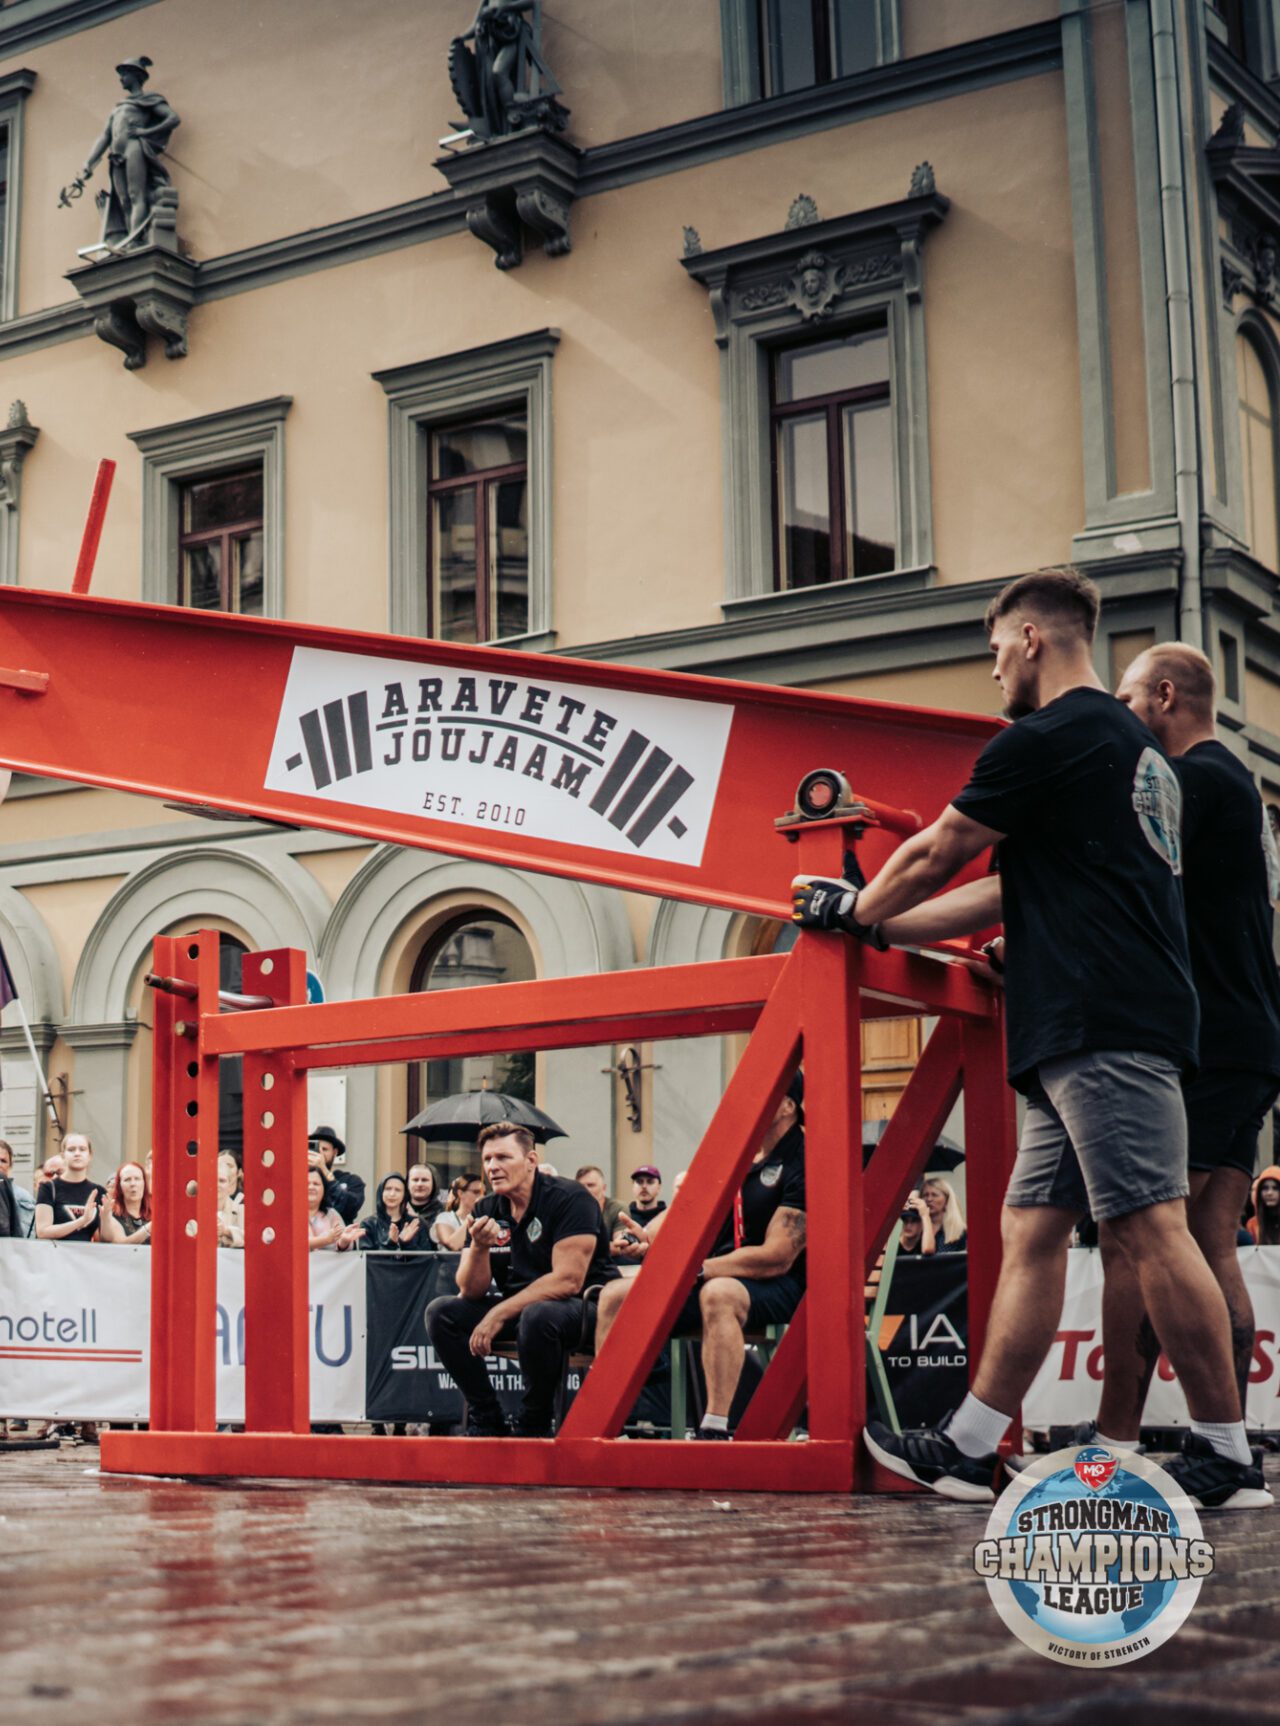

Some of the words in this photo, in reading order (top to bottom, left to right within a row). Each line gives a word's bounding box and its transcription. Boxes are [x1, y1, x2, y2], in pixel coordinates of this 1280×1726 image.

[381, 677, 618, 752] ARAVETE
[423, 792, 465, 816] EST.
[476, 801, 526, 826] 2010
[888, 1356, 911, 1368] TO
[917, 1355, 967, 1367] BUILD
